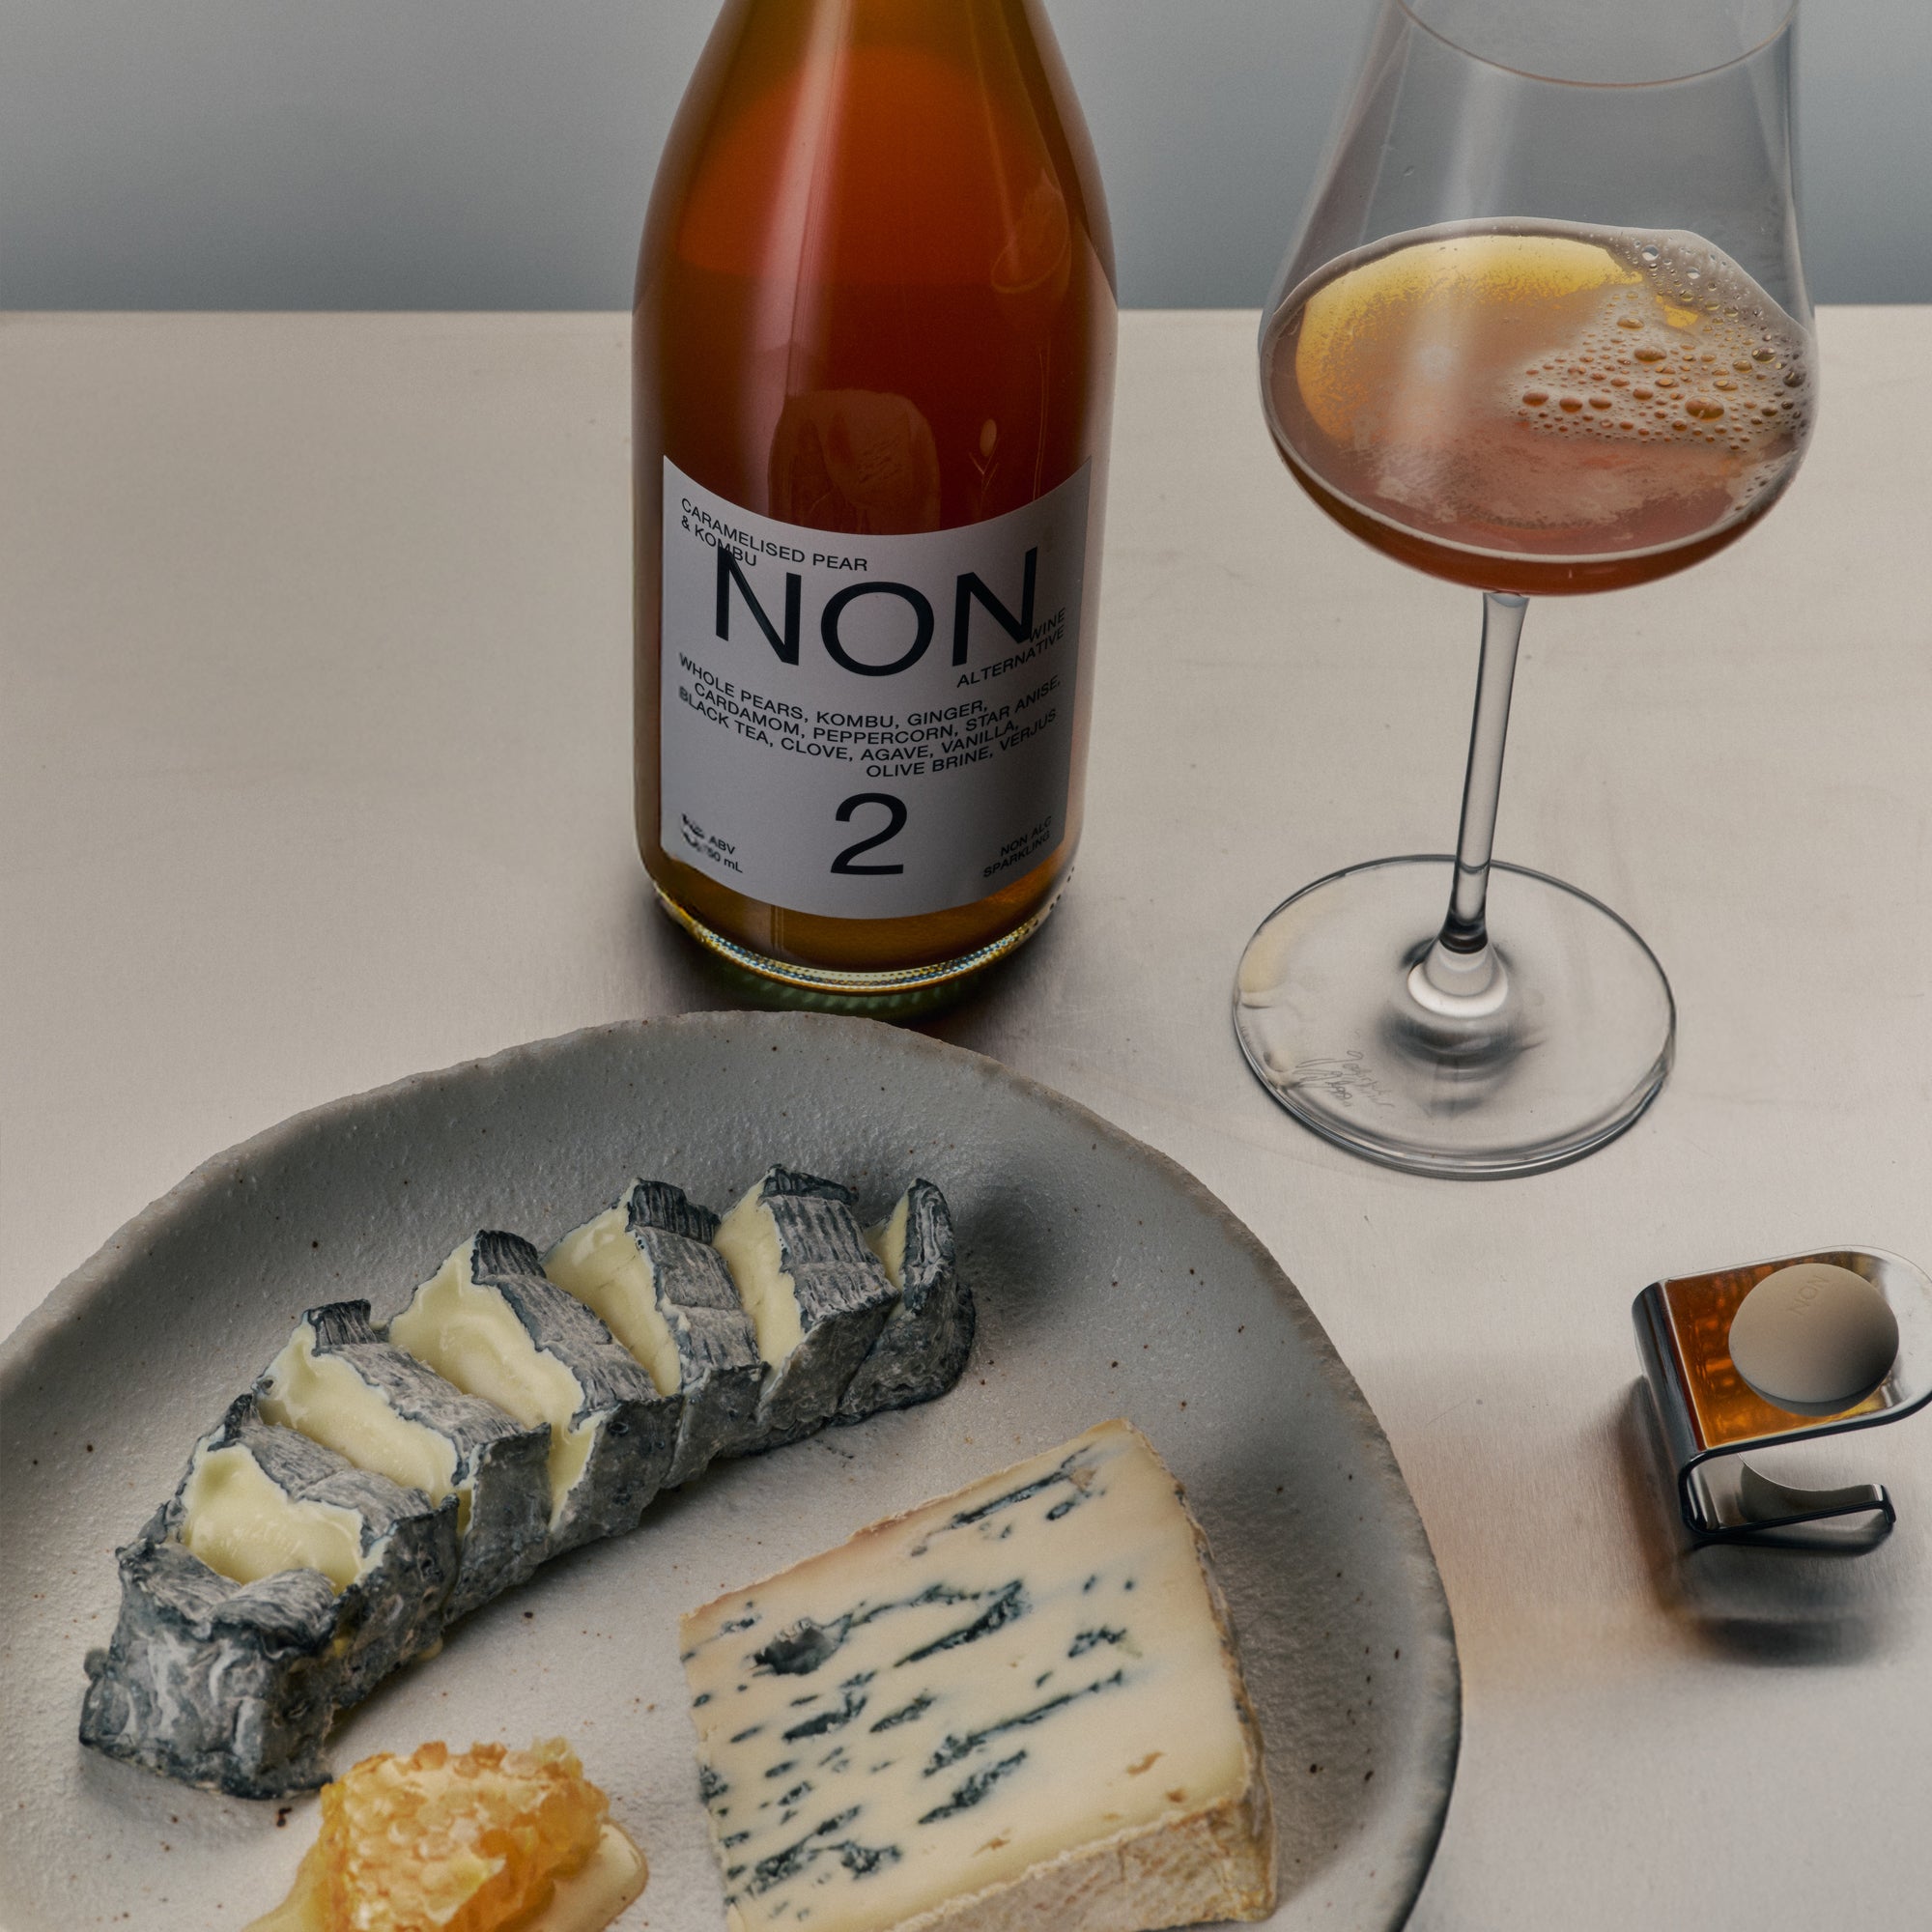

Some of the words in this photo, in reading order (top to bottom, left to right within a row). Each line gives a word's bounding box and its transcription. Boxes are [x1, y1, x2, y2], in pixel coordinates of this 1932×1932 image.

[681, 497, 805, 562] CARAMELISED
[812, 553, 867, 571] PEAR
[681, 515, 691, 531] &
[695, 524, 756, 566] KOMBU
[716, 545, 1037, 676] NON
[1028, 607, 1066, 642] WINE
[956, 625, 1065, 688] ALTERNATIVE
[679, 652, 735, 697] WHOLE
[741, 690, 809, 723] PEARS,
[816, 711, 899, 729] KOMBU,
[907, 700, 988, 726] GINGER,
[695, 682, 805, 739] CARDAMOM,
[813, 724, 958, 745] PEPPERCORN,
[965, 706, 1010, 731] STAR
[679, 686, 729, 728] BLACK
[734, 720, 773, 748] TEA,
[781, 737, 853, 762] CLOVE,
[861, 745, 934, 761] AGAVE,
[942, 721, 1019, 753] VANILLA,
[866, 762, 925, 778] OLIVE
[932, 747, 993, 773] BRINE,
[999, 708, 1057, 751] VERJUS
[709, 836, 735, 854] ABV
[724, 858, 743, 873] mL
[830, 793, 908, 875] 2
[983, 830, 1050, 877] SPARKLING
[1001, 835, 1028, 857] NON
[1031, 815, 1052, 838] ALC
[1788, 1274, 1830, 1316] NON
